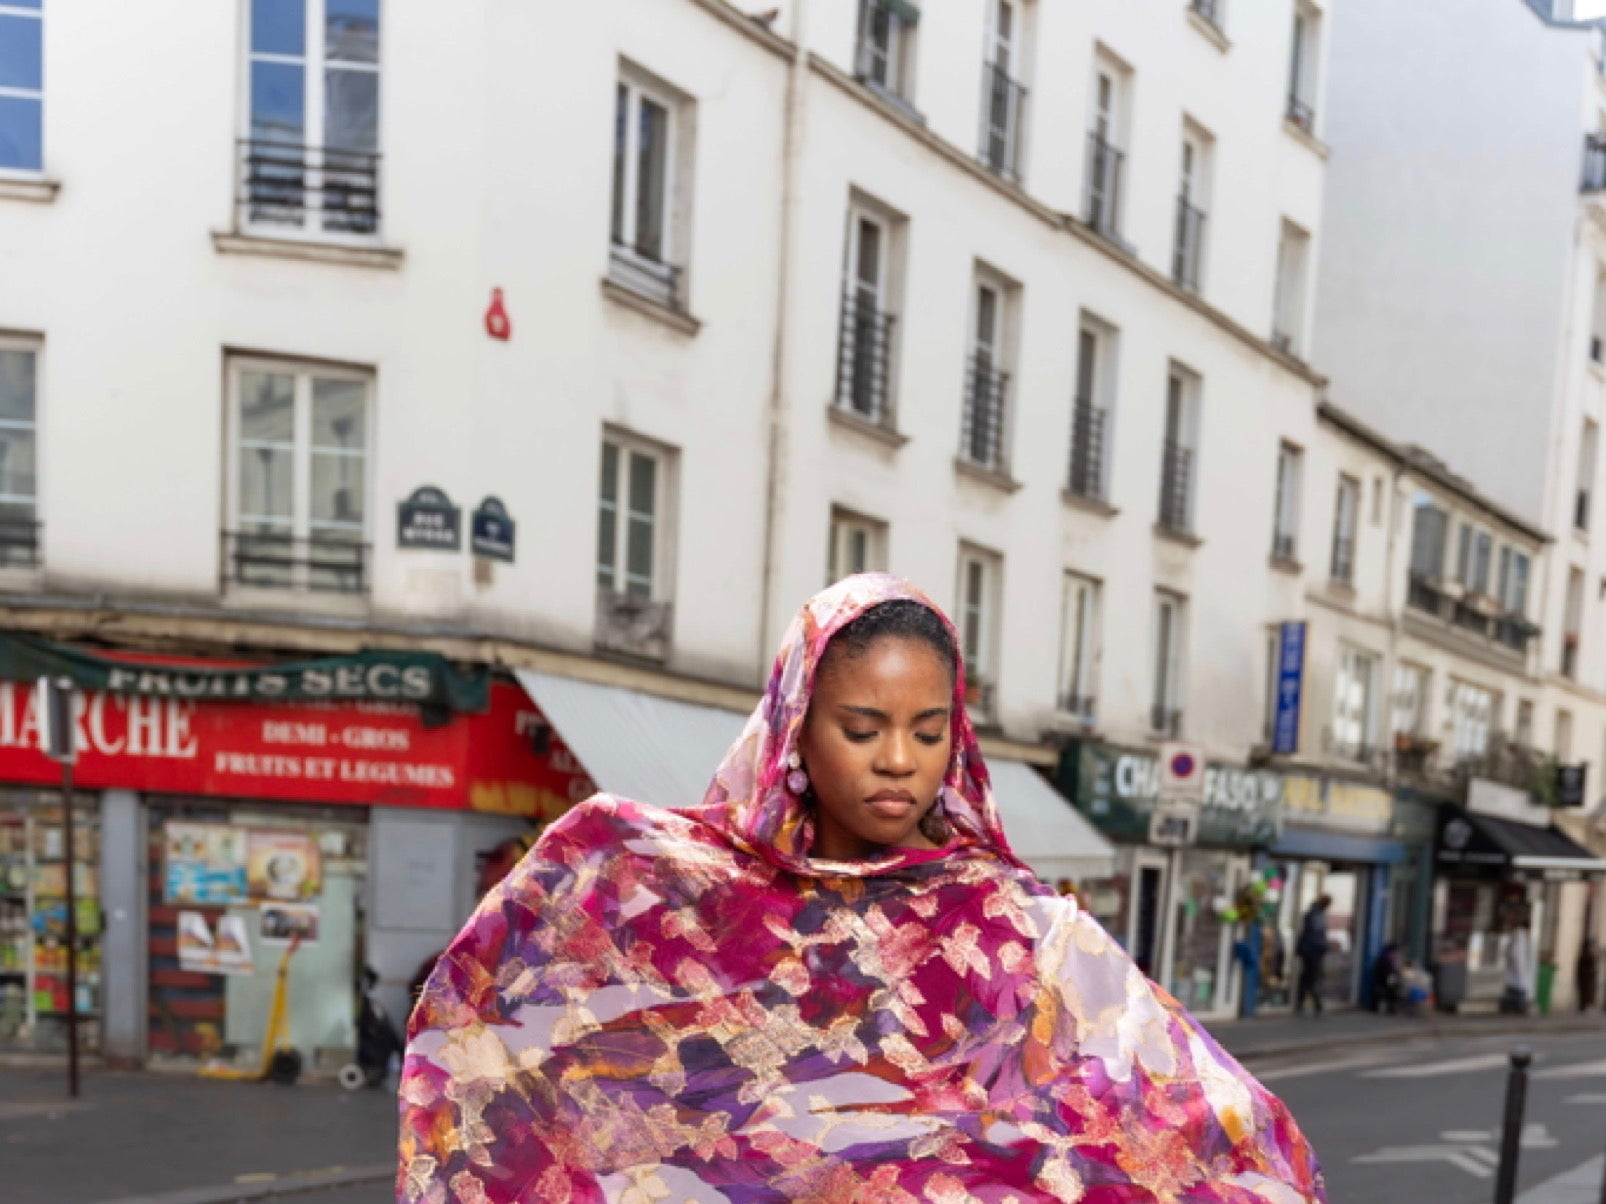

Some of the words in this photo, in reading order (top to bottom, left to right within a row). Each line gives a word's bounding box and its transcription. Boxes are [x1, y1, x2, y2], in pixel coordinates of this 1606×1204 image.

[303, 664, 430, 694] SECS
[0, 683, 198, 758] ACHE
[262, 721, 326, 745] DEMI
[342, 726, 410, 751] GROS
[214, 752, 301, 776] FRUITS
[304, 757, 335, 779] ET
[339, 760, 455, 788] LEGUMES
